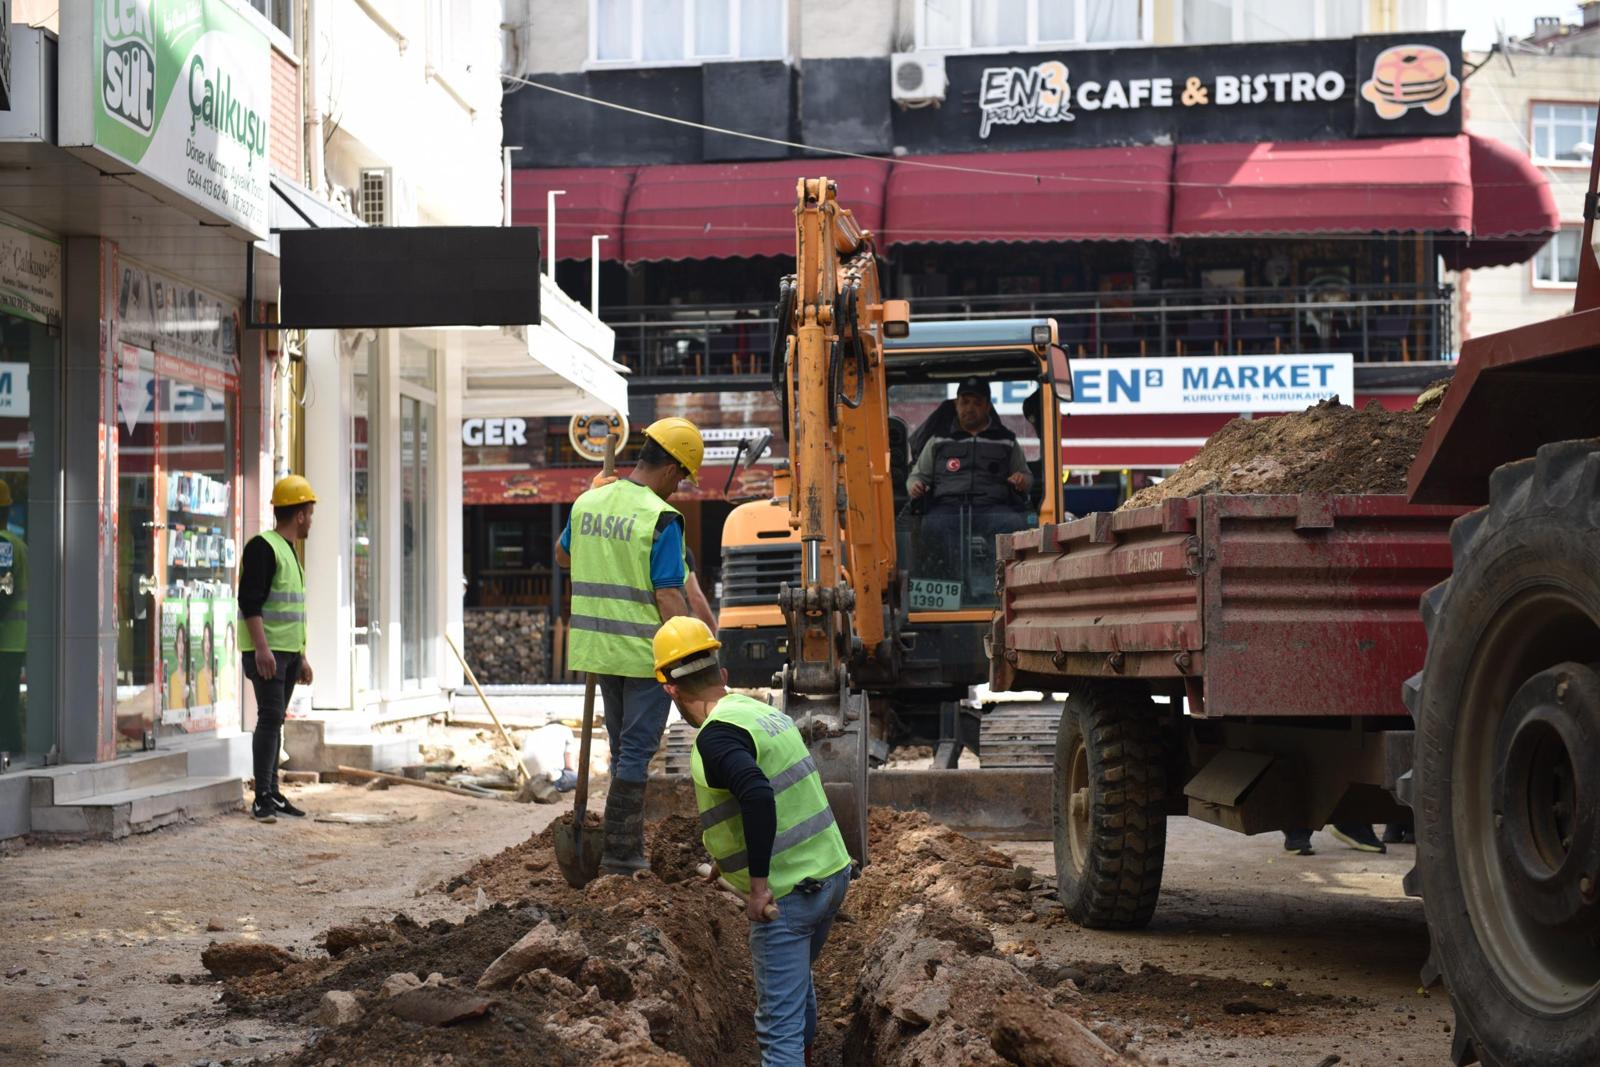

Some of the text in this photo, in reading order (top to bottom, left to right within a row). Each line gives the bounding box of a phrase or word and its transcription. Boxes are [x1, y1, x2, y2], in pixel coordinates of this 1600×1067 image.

[979, 61, 1071, 109] EN3
[1076, 78, 1174, 111] CAFE
[1181, 77, 1209, 106] &
[188, 54, 266, 170] Çalıkuşu
[186, 138, 206, 165] Döner
[187, 167, 202, 190] 0544
[1182, 364, 1334, 390] MARKET
[462, 417, 527, 446] GER
[580, 512, 636, 542] BASKİ
[913, 595, 944, 607] 1390
[945, 584, 959, 596] 18
